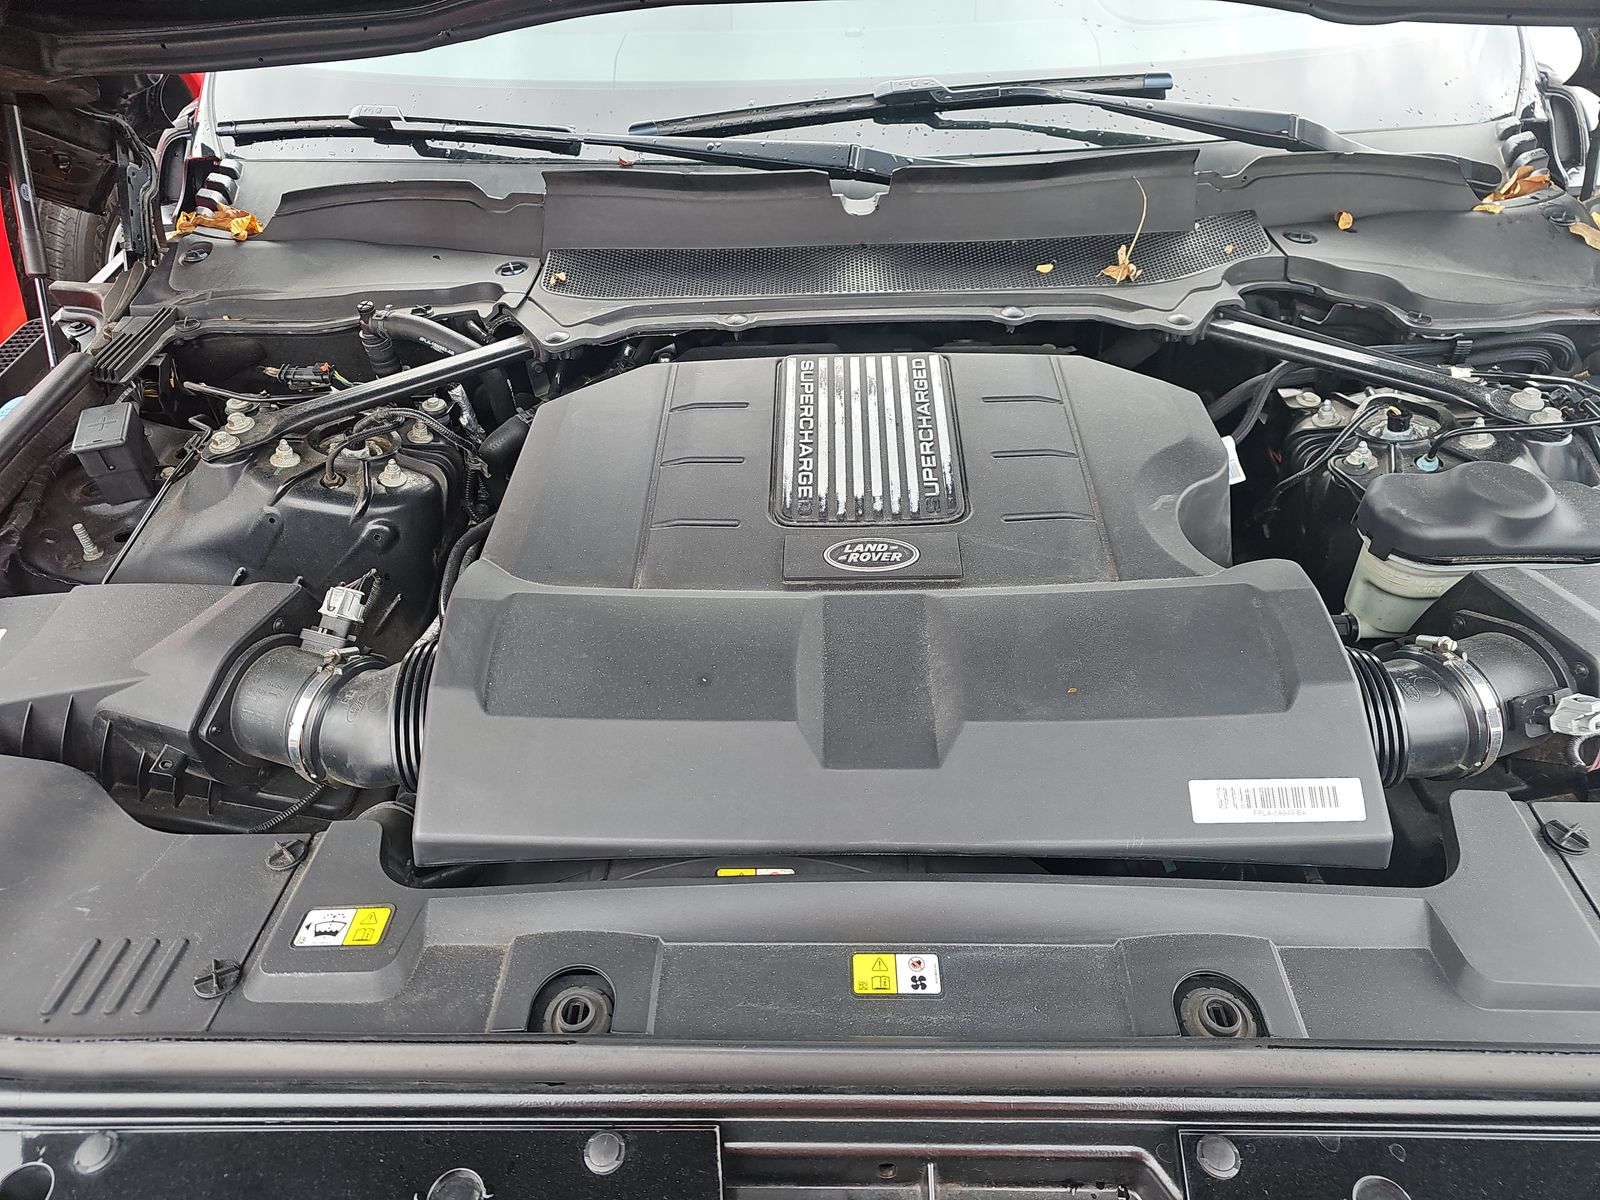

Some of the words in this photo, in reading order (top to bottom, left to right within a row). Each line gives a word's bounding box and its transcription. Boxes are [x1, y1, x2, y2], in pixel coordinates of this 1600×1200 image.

[798, 360, 815, 517] SUPERCHARGED
[911, 358, 941, 513] SUPERCHARGED
[843, 543, 889, 553] LAND
[847, 552, 903, 563] ROVER
